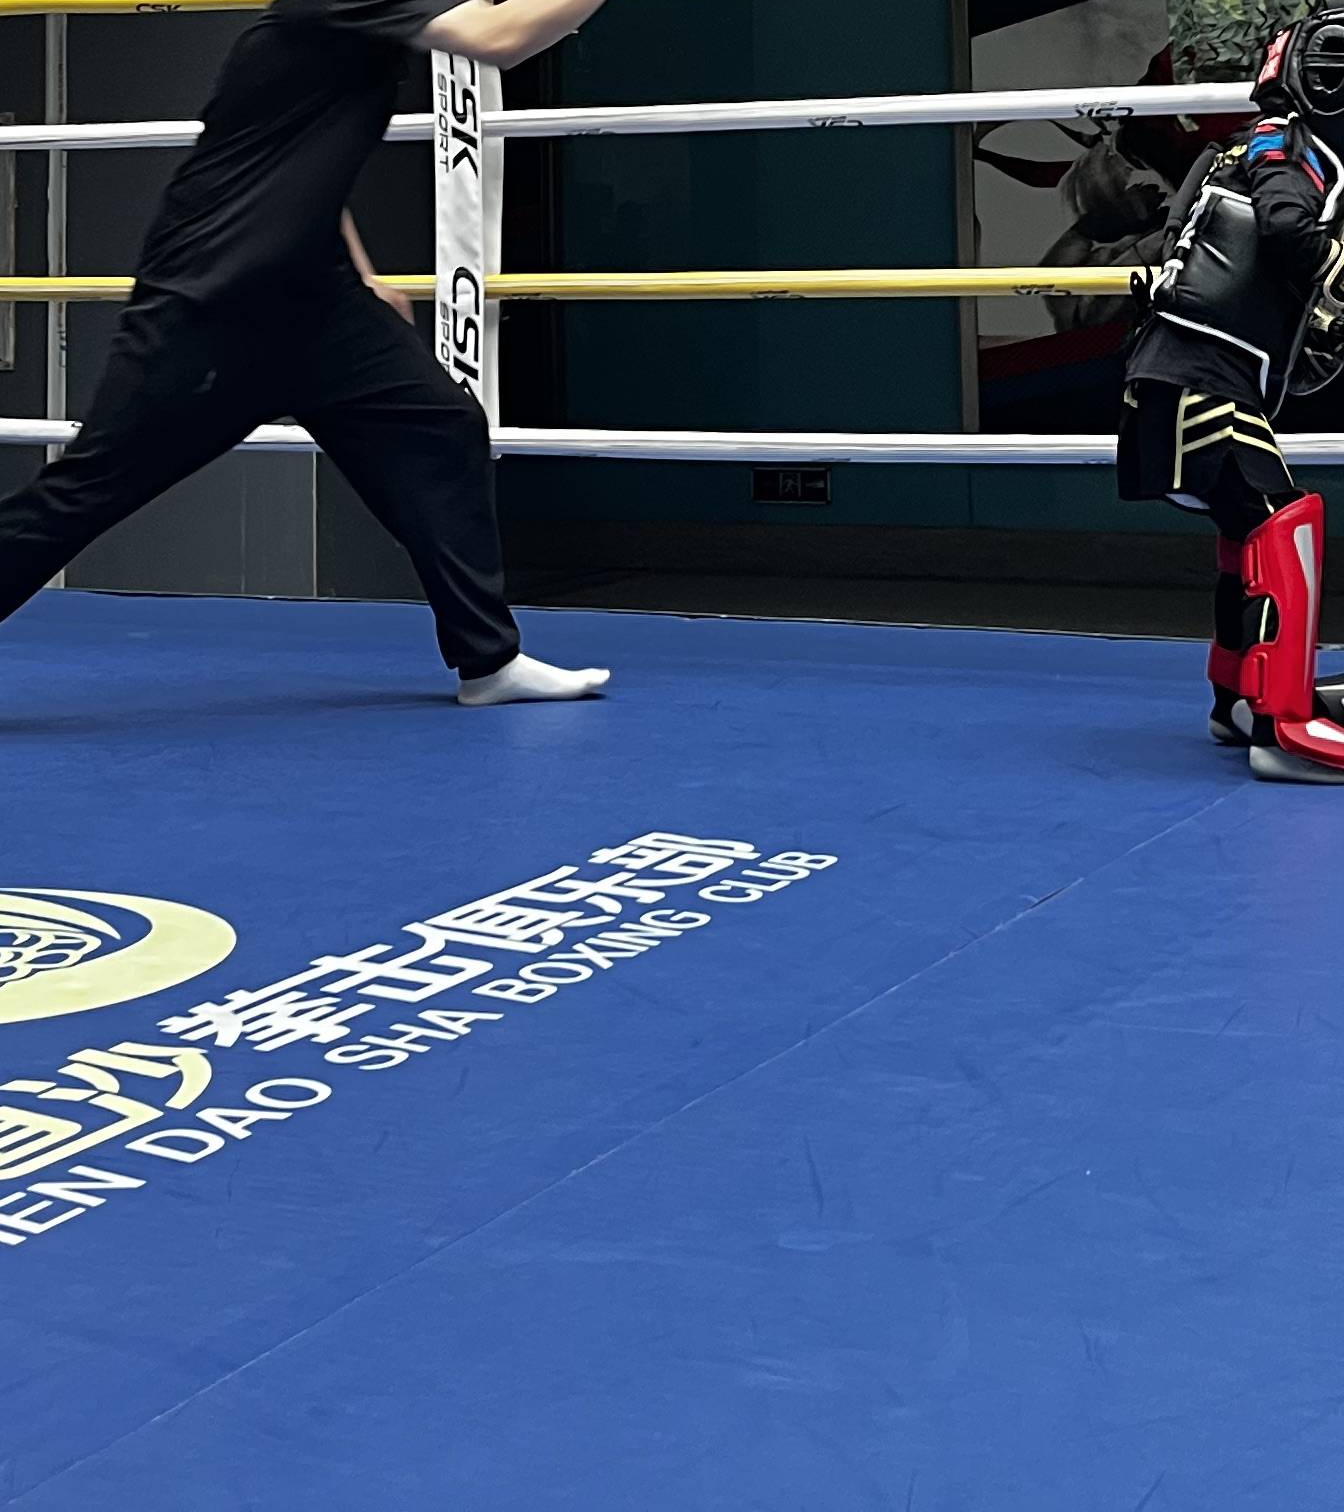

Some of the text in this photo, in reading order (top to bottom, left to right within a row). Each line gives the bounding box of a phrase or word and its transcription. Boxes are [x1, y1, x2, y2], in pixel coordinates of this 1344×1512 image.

[437, 71, 450, 174] SPORT
[439, 300, 451, 376] SPO
[124, 1077, 333, 1164] DAO
[324, 1008, 504, 1071] SHA
[471, 908, 712, 1004] BOXING
[697, 850, 839, 904] CLUB
